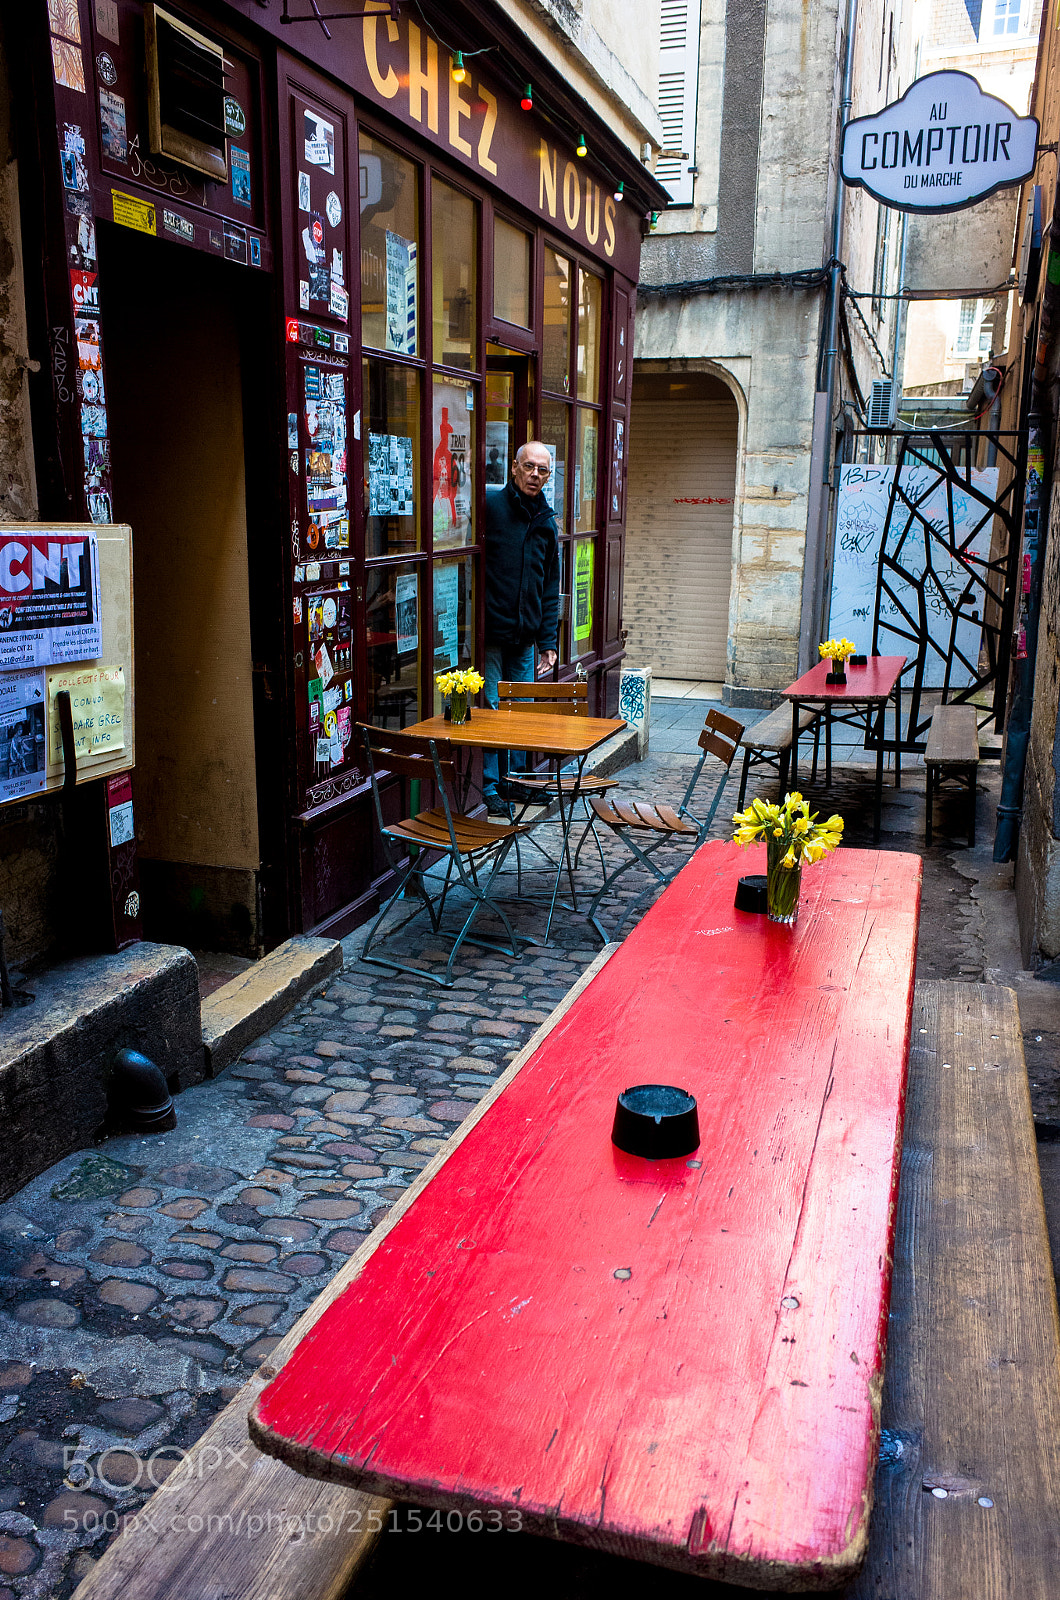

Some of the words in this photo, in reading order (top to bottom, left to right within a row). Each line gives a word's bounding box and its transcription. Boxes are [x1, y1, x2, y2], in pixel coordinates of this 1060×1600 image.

[929, 102, 948, 121] AU
[362, 0, 498, 177] CHEZ
[539, 138, 616, 257] NOUS
[860, 122, 1012, 170] COMPTOIR
[904, 175, 918, 189] DU
[920, 172, 963, 188] MARCHE
[73, 284, 99, 305] CNT
[0, 541, 85, 593] CNT
[58, 674, 98, 688] COLLECTE
[99, 671, 119, 682] POUR
[98, 713, 121, 727] GREC
[92, 733, 111, 746] INFO
